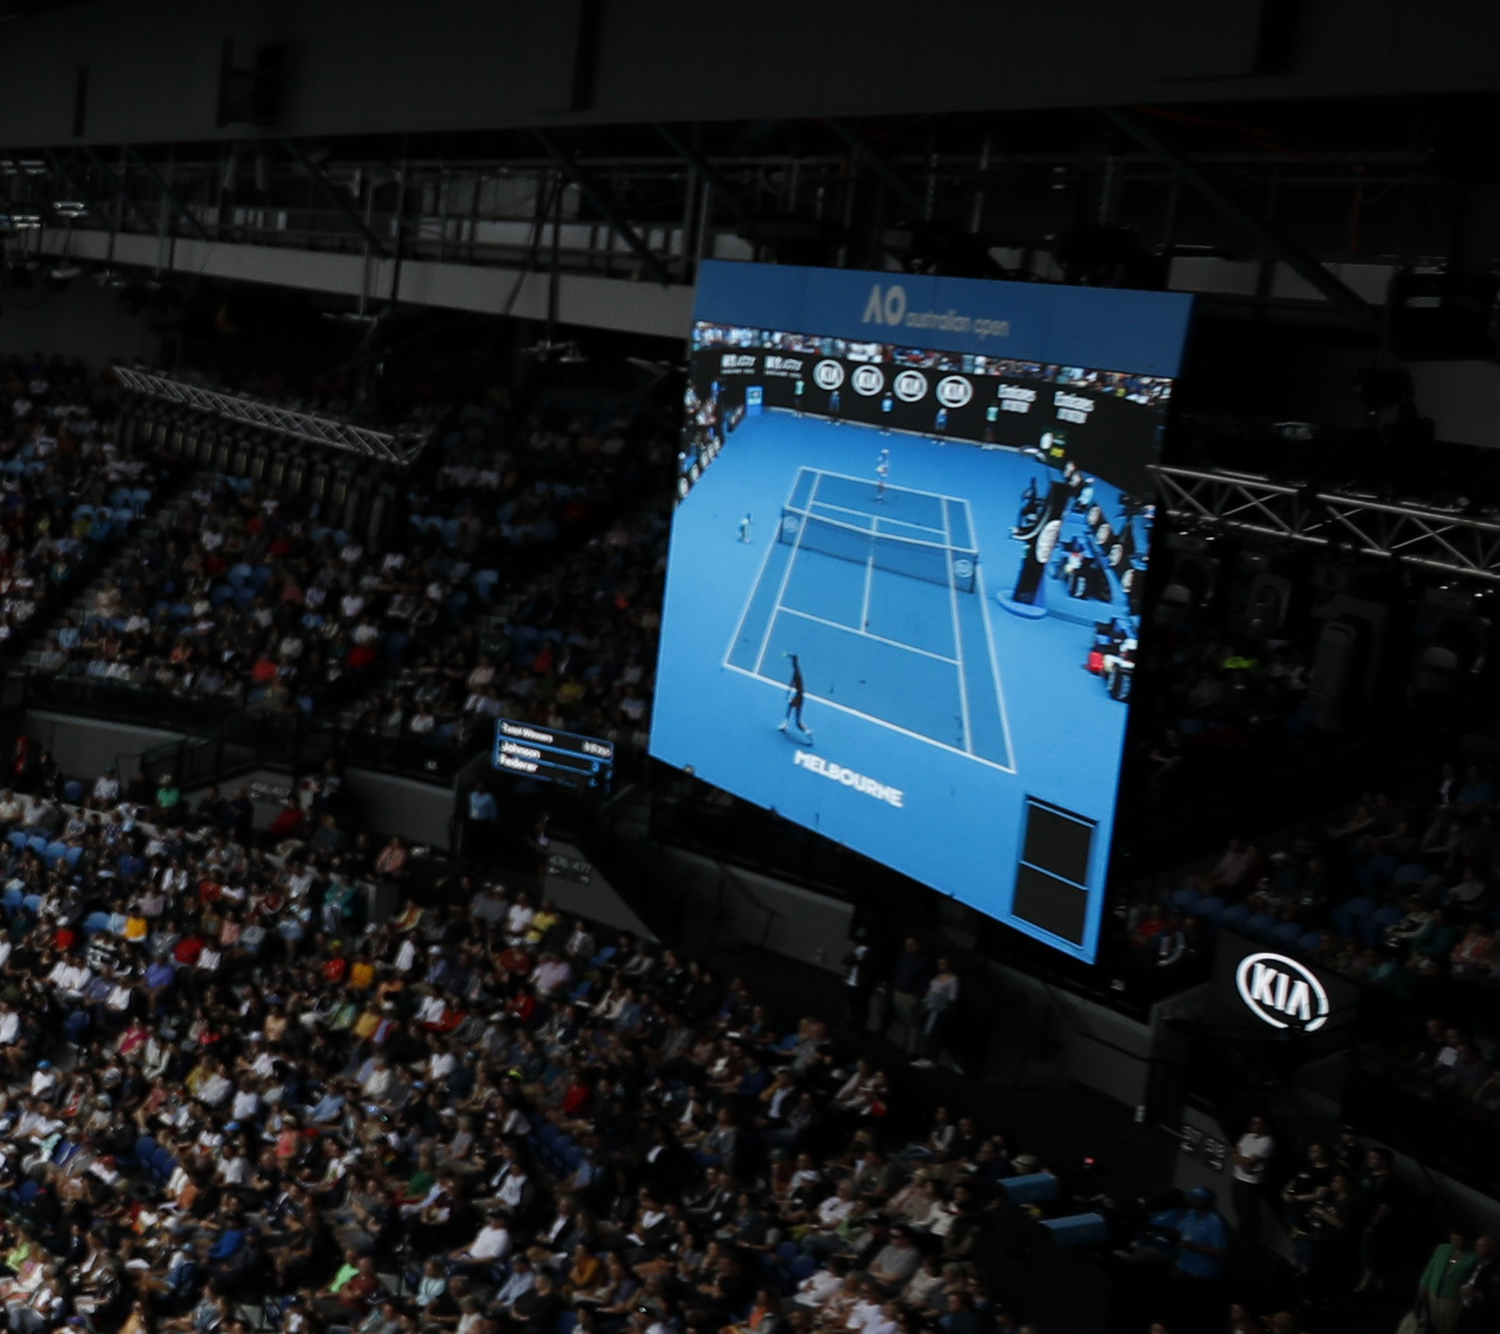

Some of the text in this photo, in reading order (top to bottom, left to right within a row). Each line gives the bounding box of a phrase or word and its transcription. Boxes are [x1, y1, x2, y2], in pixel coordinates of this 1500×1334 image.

[862, 284, 907, 326] AO
[501, 741, 541, 760] Johnson
[793, 749, 904, 808] MELBOURNE
[1251, 962, 1311, 1021] KIA
